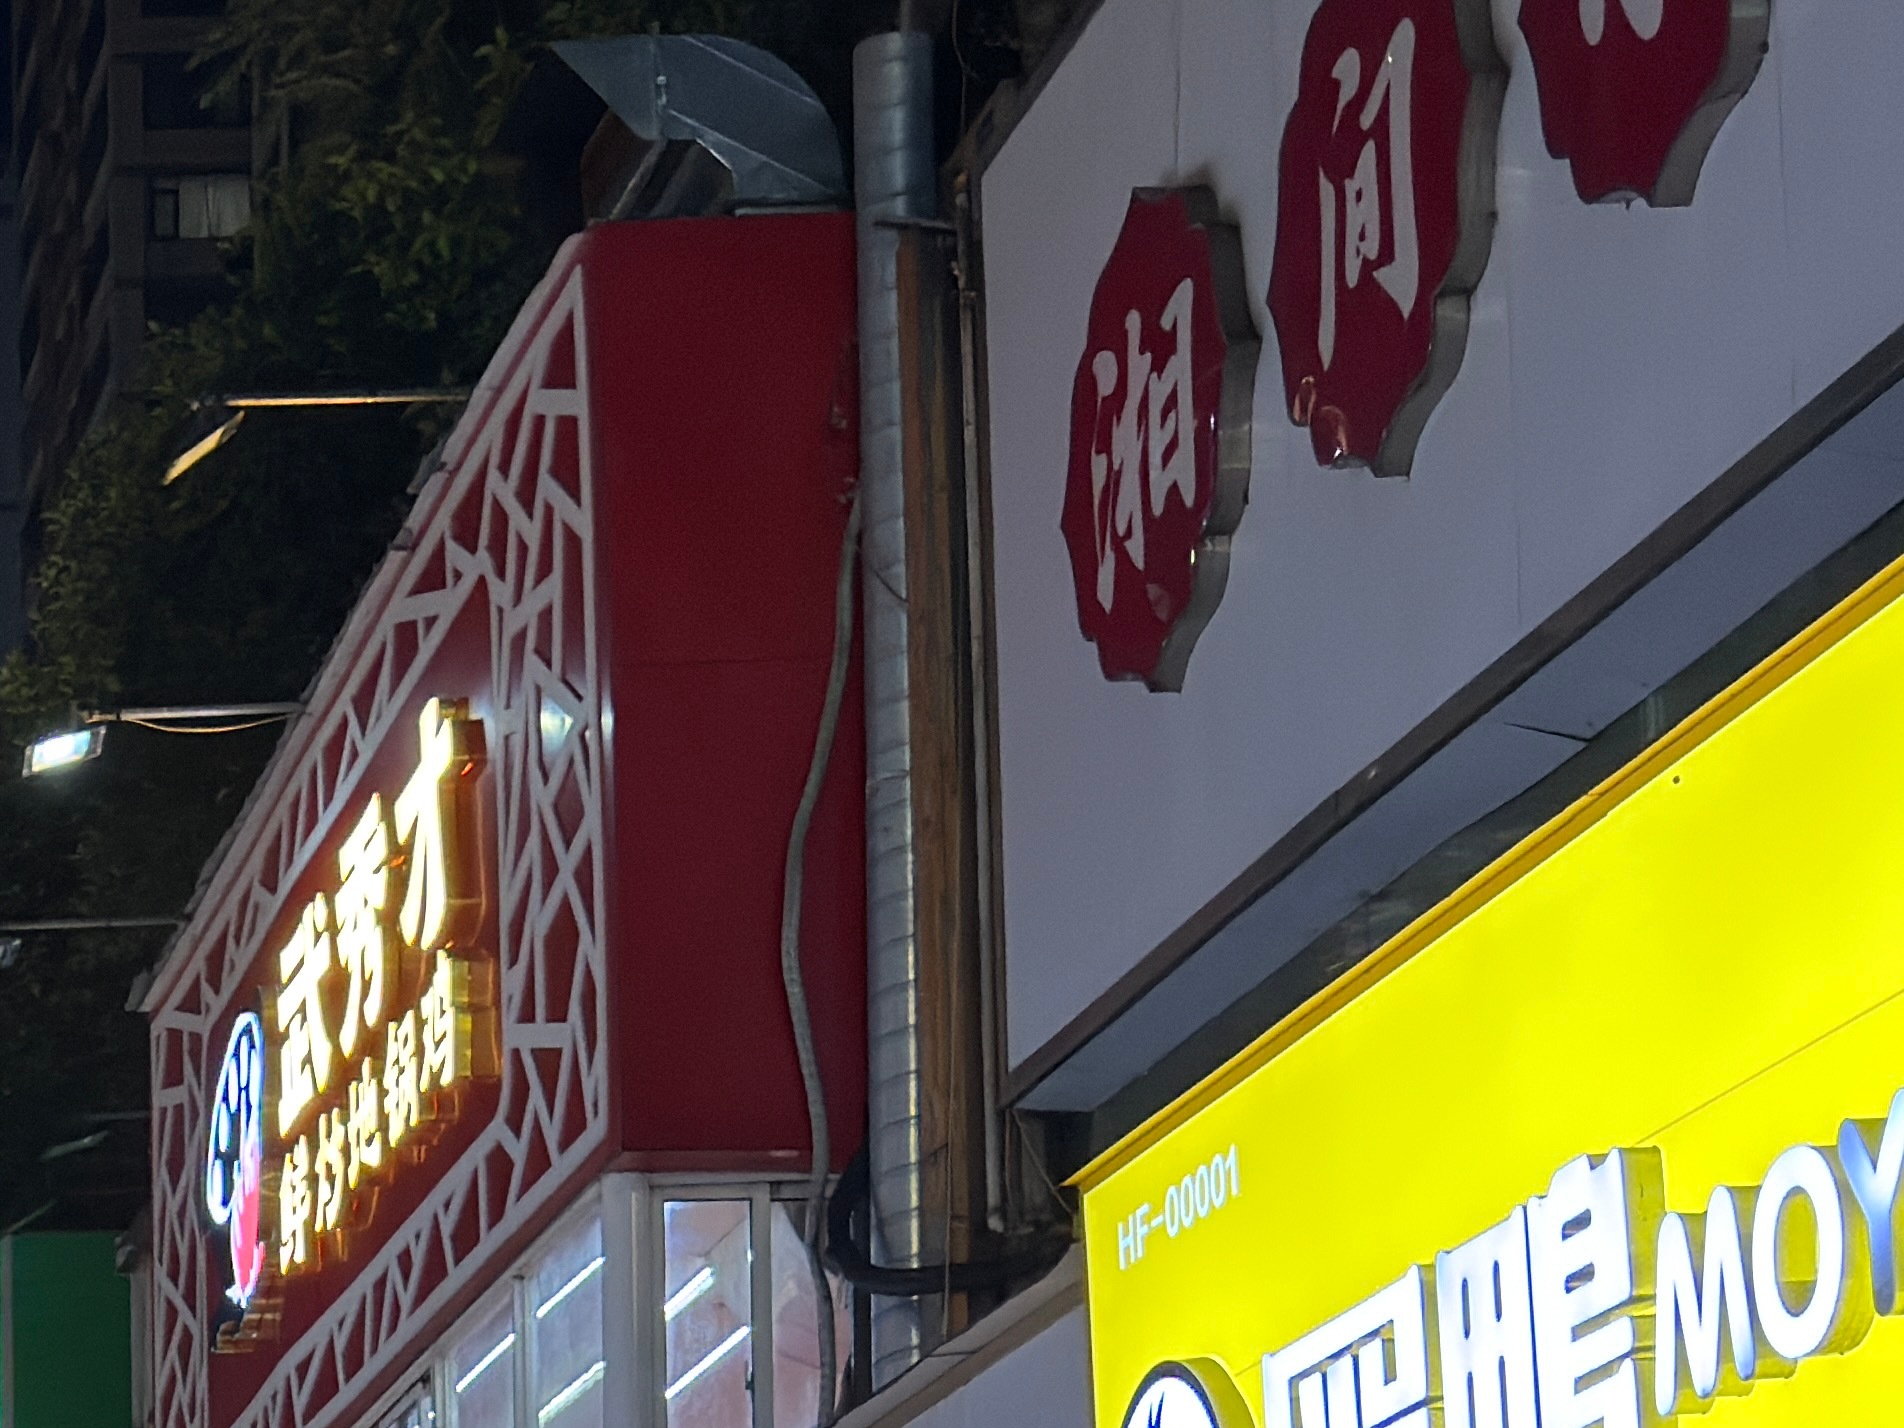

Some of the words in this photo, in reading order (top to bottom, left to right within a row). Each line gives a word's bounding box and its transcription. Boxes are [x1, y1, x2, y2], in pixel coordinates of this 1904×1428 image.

[278, 697, 455, 1138] 武秀才
[1116, 1144, 1242, 1270] HF-00001
